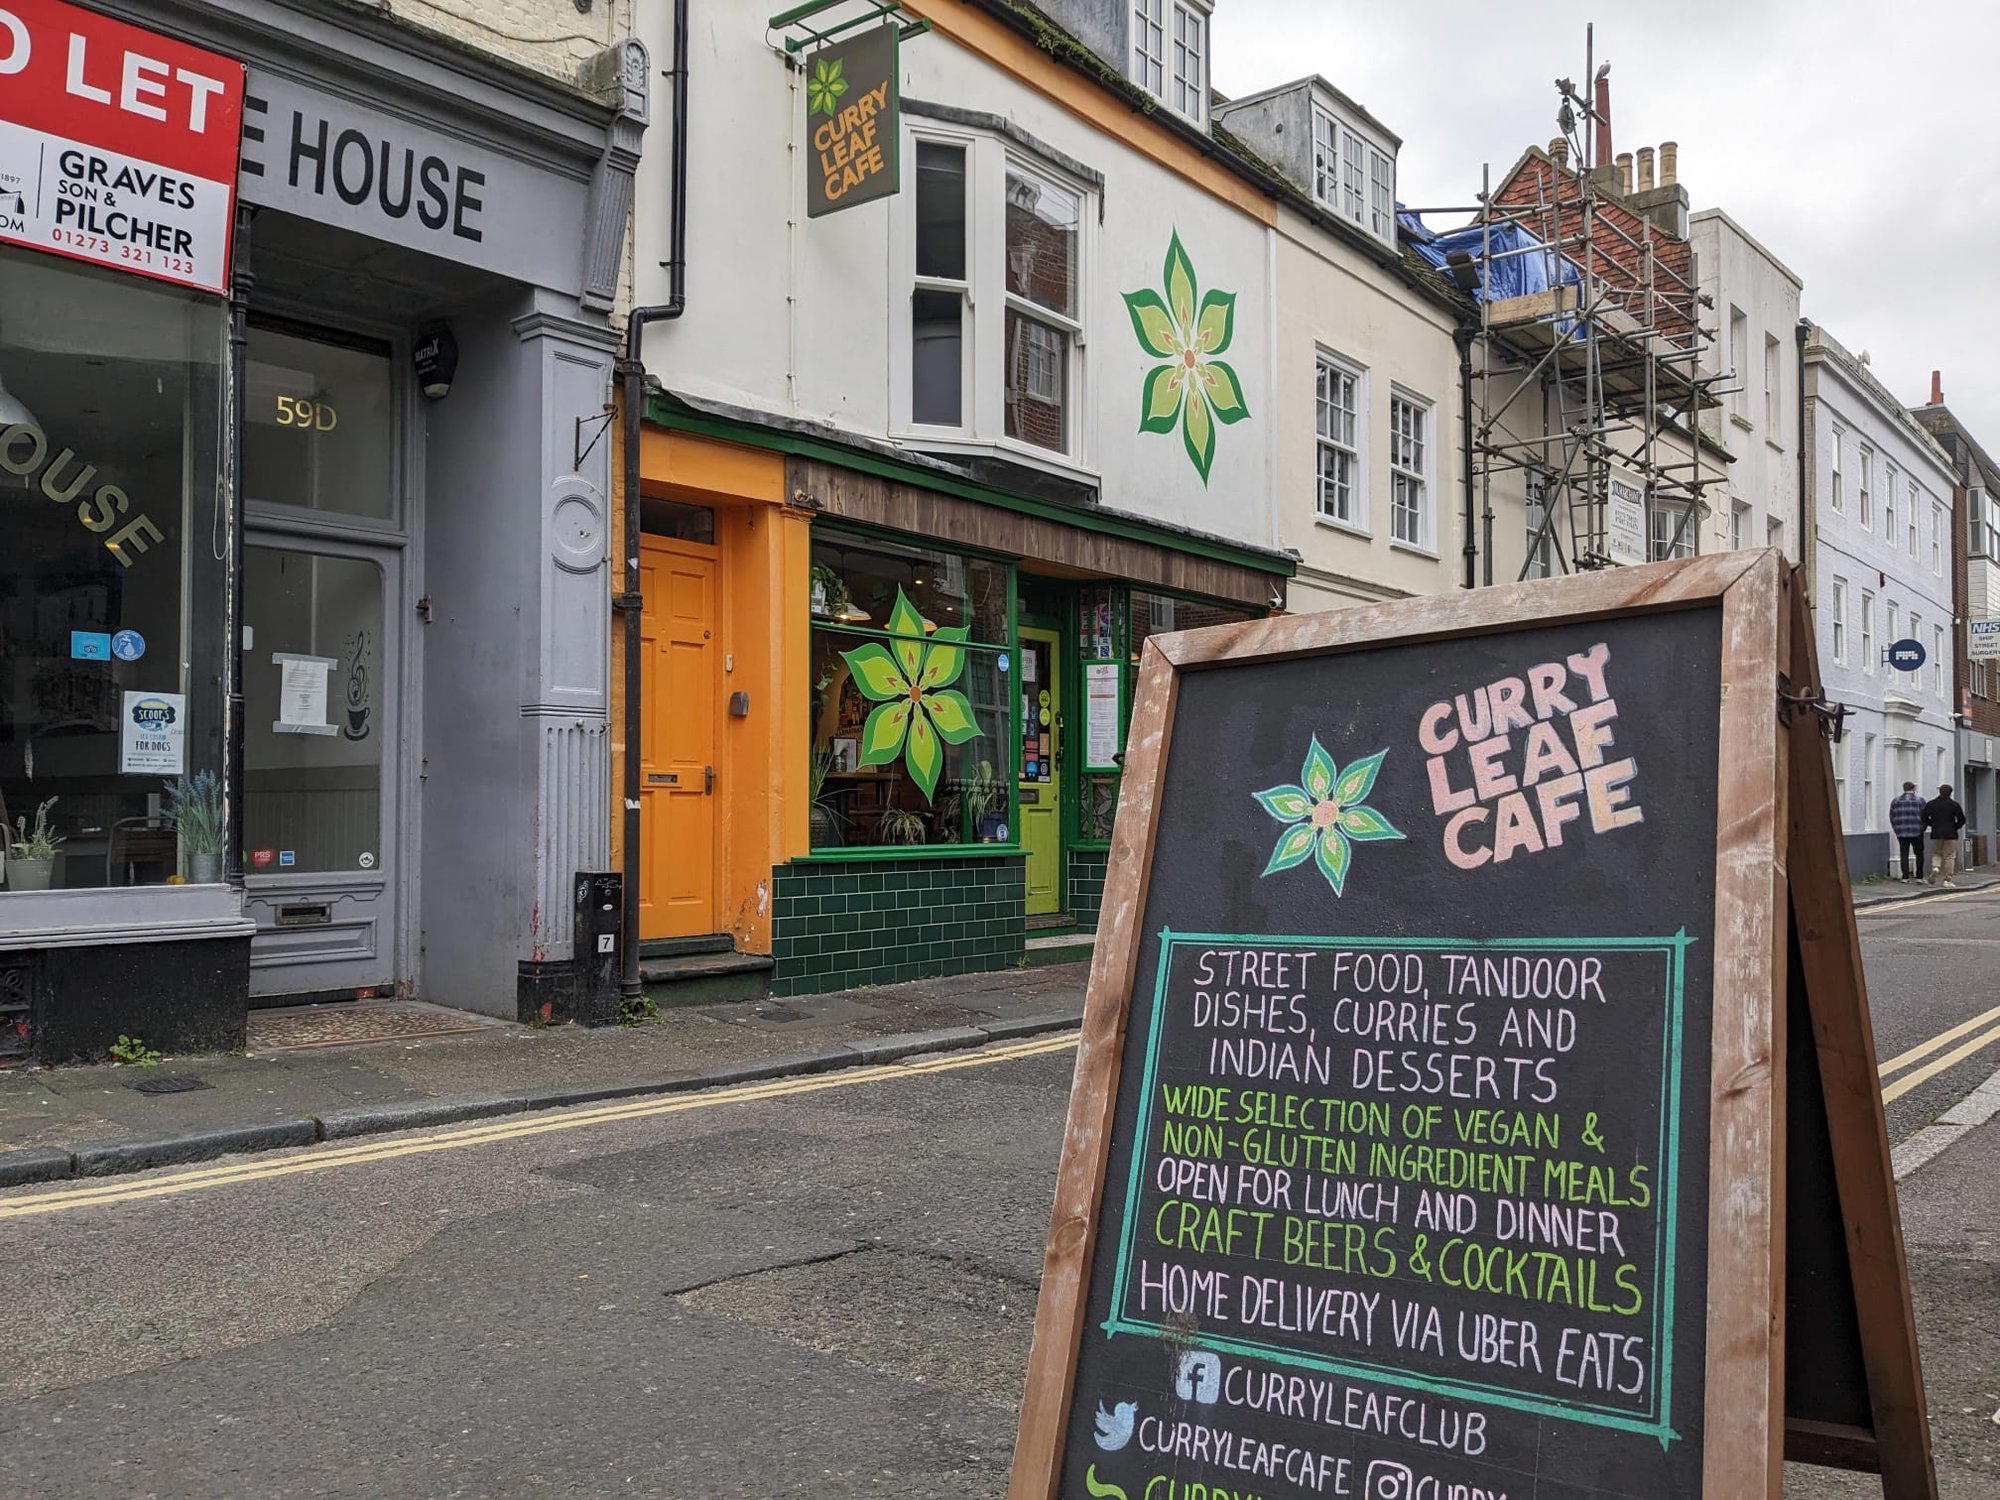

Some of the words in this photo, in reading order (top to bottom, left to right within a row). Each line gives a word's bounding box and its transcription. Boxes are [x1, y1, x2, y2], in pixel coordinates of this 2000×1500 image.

[66, 32, 225, 134] LET
[814, 80, 888, 151] CURRY
[59, 150, 195, 210] GRAVES
[288, 110, 485, 243] HOUSE
[820, 119, 876, 177] LEAF
[825, 144, 885, 201] CAFE
[55, 197, 194, 258] PILCHER
[58, 179, 98, 206] SON
[103, 192, 117, 207] &
[52, 228, 109, 253] 01273
[121, 245, 152, 264] 321
[162, 256, 194, 275] 123
[276, 396, 338, 431] 59D
[0, 423, 165, 568] OUSE
[1973, 622, 2000, 634] NHS
[1418, 642, 1611, 756] CURRY
[151, 741, 171, 752] DOGS
[1425, 699, 1619, 816] LEAF
[1443, 756, 1645, 870] CAFE
[602, 937, 611, 950] 7
[1193, 950, 1317, 990] STREET
[1333, 952, 1428, 1001] FOOD,
[1441, 954, 1606, 1004] TANDOOR
[1193, 991, 1315, 1042] DISHES,
[1333, 997, 1477, 1045] CURRIES
[1500, 1007, 1576, 1052] AND
[1210, 1037, 1330, 1085] INDIAN
[1352, 1048, 1557, 1103] DESSERTS
[1162, 1083, 1231, 1122] WIDE
[1234, 1090, 1390, 1137] SELECTION
[1402, 1104, 1443, 1140] OF
[1453, 1108, 1559, 1149] VEGAN
[1581, 1112, 1605, 1153] &
[1163, 1120, 1356, 1174] NON-GLUTEN
[1369, 1142, 1535, 1198] INGREDIENT
[1544, 1158, 1651, 1208] MEALS
[1157, 1157, 1229, 1205] OPEN
[1237, 1165, 1292, 1211] FOR
[1304, 1174, 1399, 1224] LUNCH
[1414, 1189, 1477, 1235] AND
[1496, 1199, 1625, 1258] DINNER
[1155, 1200, 1275, 1260] CRAFT
[1283, 1216, 1397, 1279] BEERS
[1408, 1233, 1432, 1283] &
[1439, 1238, 1642, 1315] COCKTAILS
[1141, 1260, 1230, 1321] HOME
[1241, 1275, 1380, 1347] DELIVERY
[1392, 1299, 1444, 1357] VIA
[1458, 1311, 1543, 1374] UBER
[1556, 1328, 1645, 1395] EATS
[1224, 1366, 1487, 1455] CURRYLEAFCLUB
[1138, 1416, 1352, 1495] CURRYLEAFCAFE
